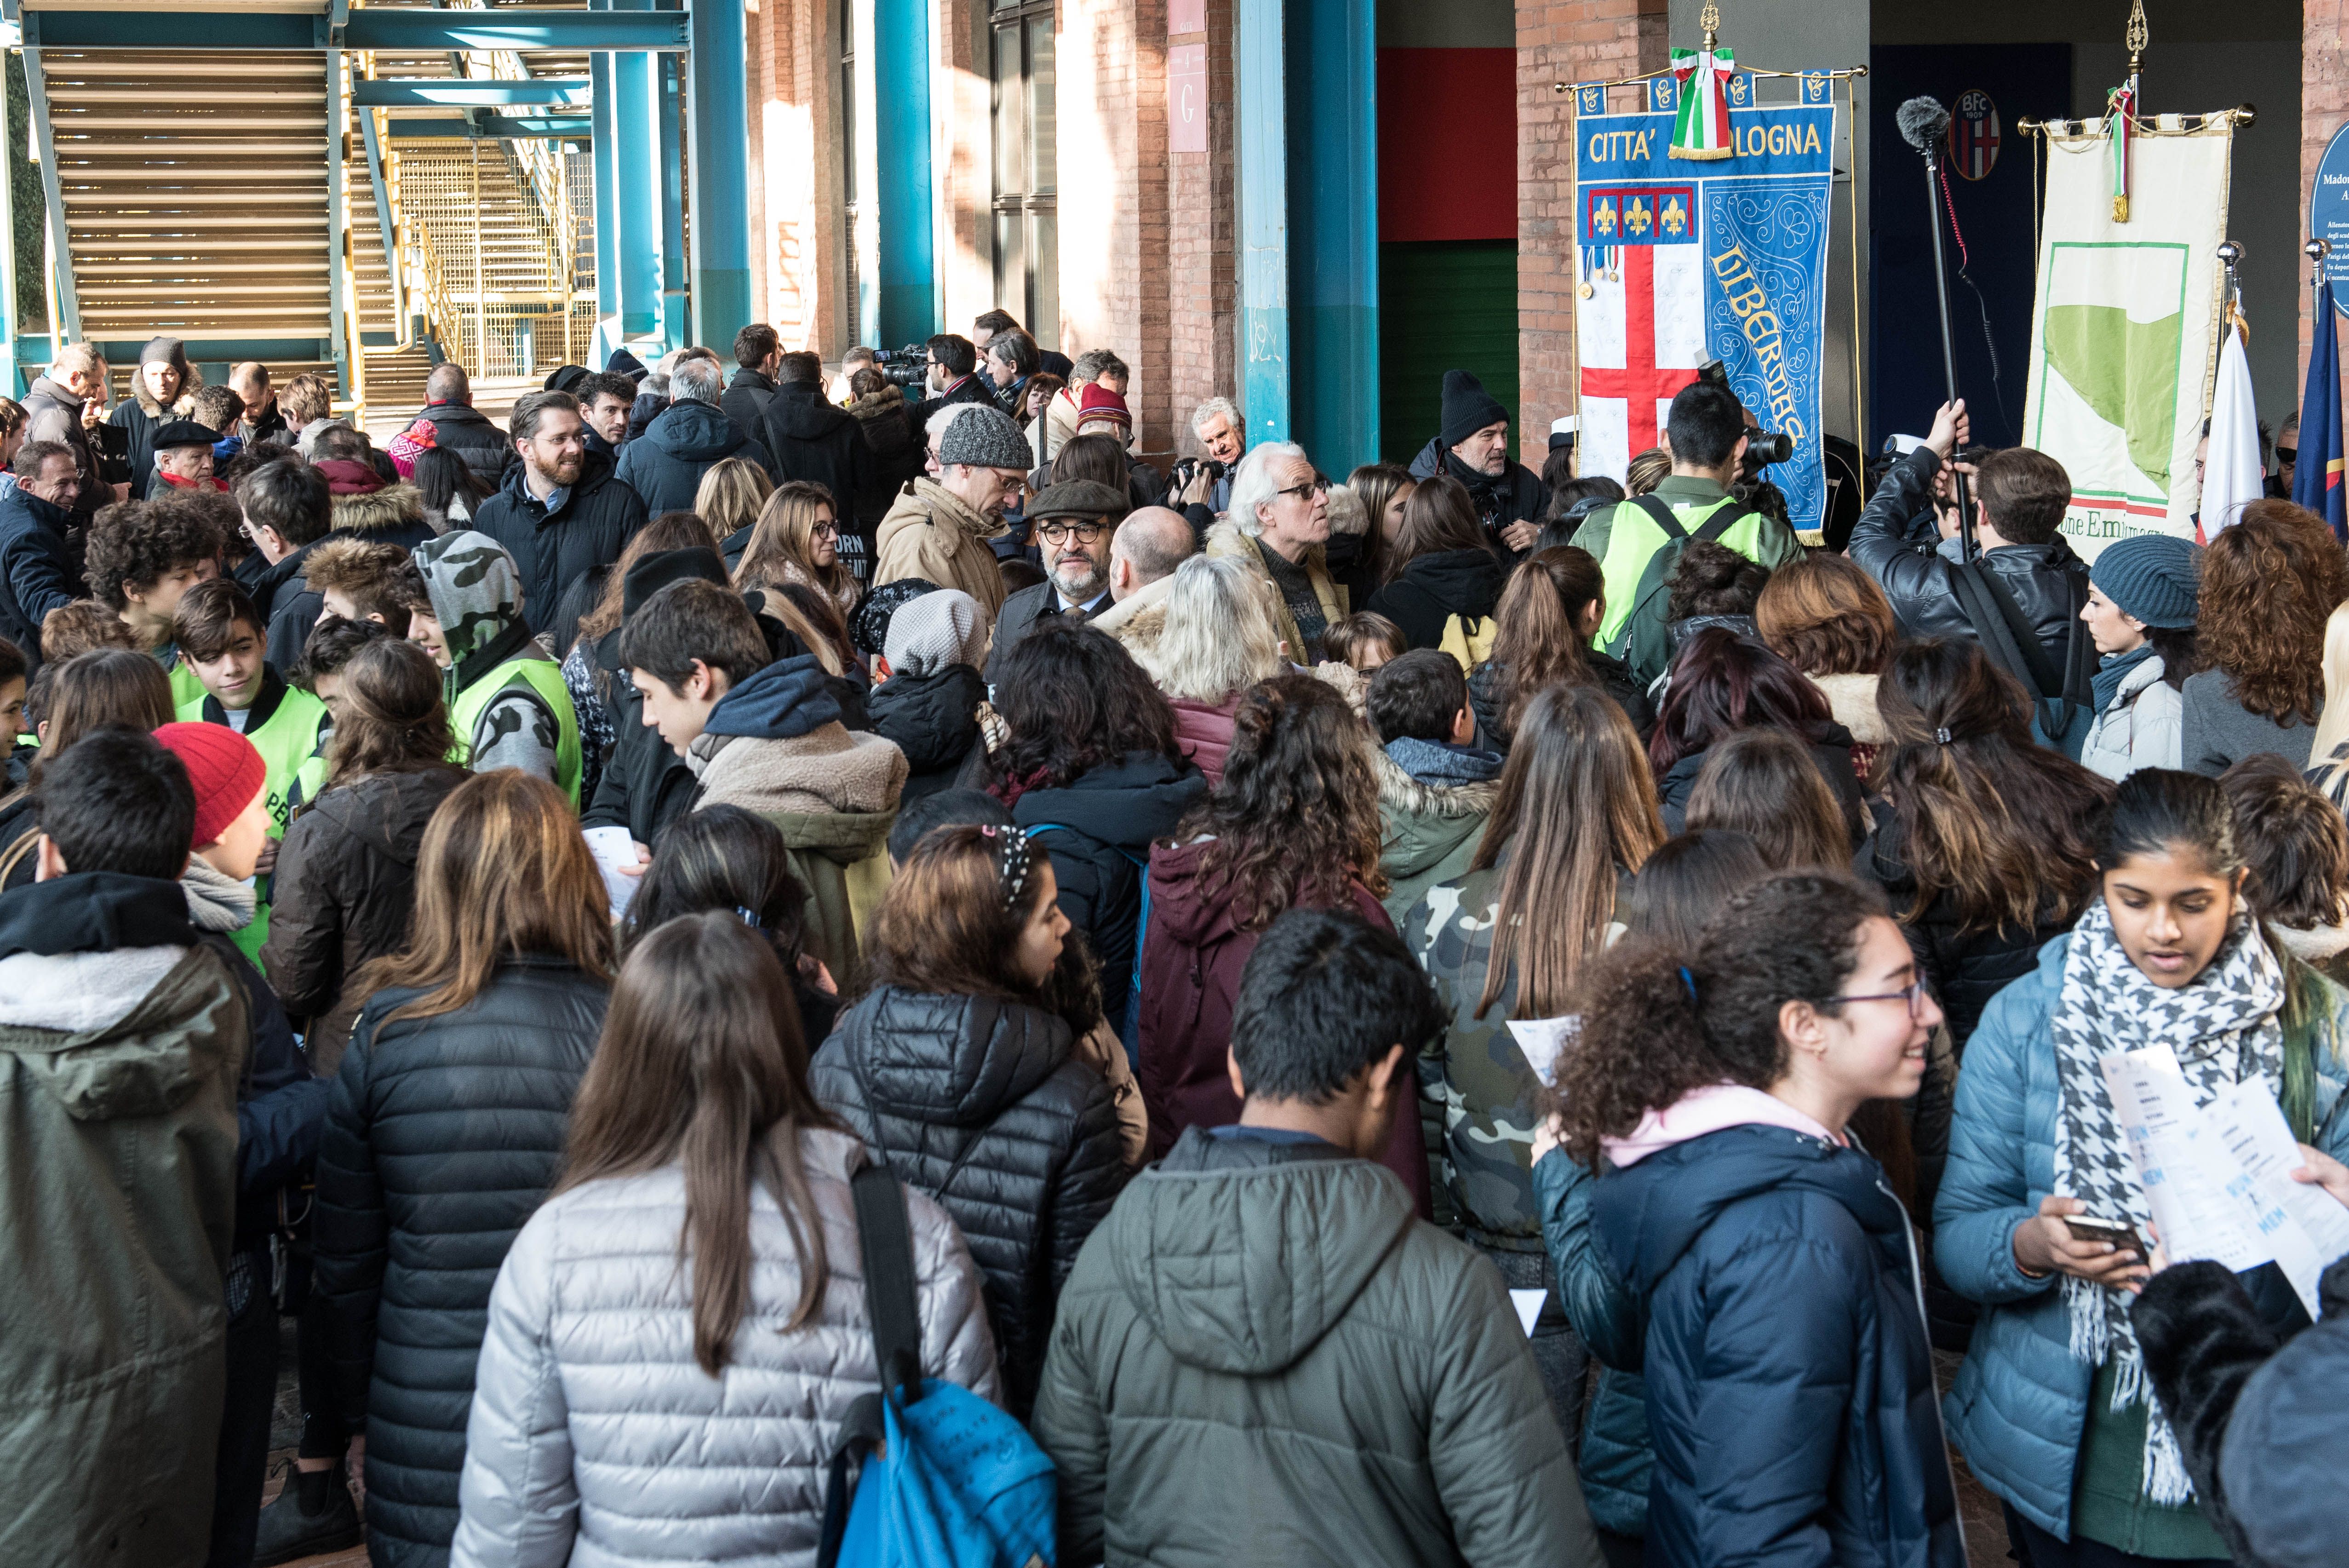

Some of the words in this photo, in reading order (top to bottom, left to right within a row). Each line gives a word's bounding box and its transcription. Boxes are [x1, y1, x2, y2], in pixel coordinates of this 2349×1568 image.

[1185, 52, 1189, 69] 4
[1181, 84, 1194, 123] G
[1962, 93, 1987, 111] BFC
[1590, 128, 1656, 163] CITTA'
[1730, 123, 1822, 156] LOGNA
[1710, 242, 1806, 448] LIBERTAS
[2055, 517, 2084, 535] one
